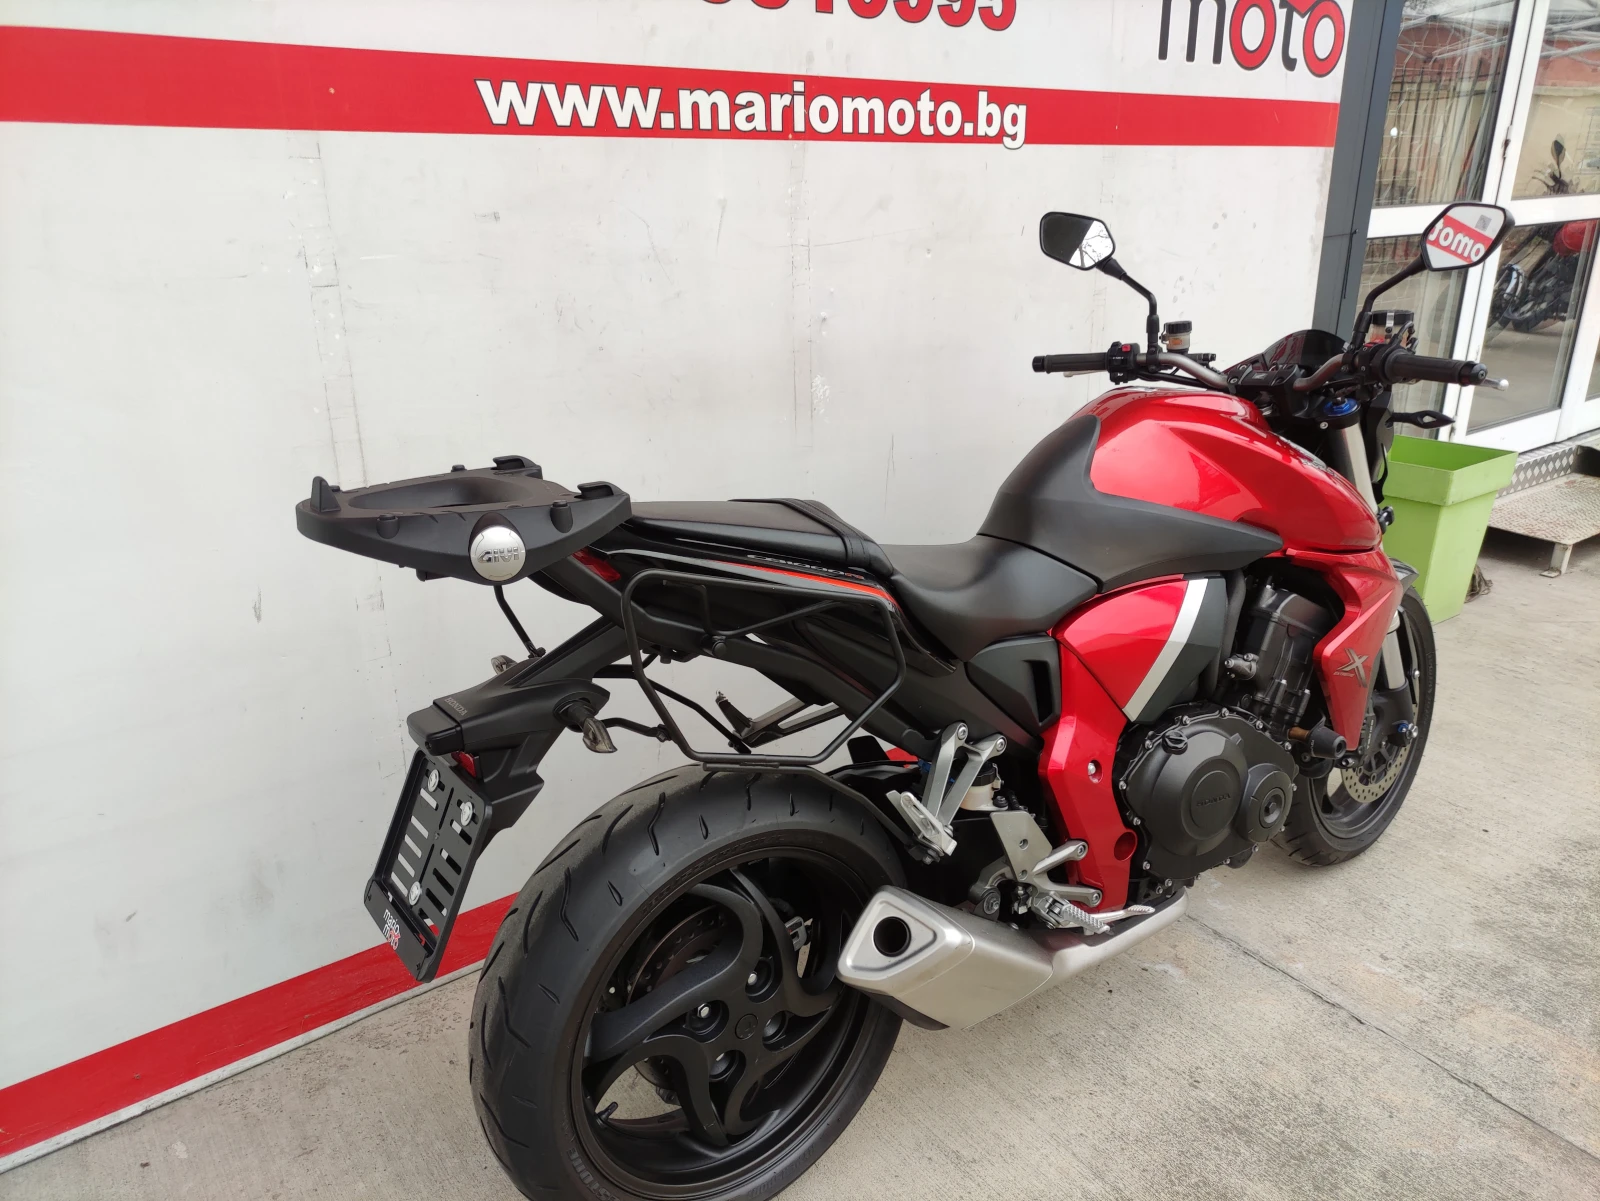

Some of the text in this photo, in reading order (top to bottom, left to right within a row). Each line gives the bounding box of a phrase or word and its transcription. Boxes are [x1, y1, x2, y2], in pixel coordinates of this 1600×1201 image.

[1158, 0, 1345, 78] moto
[474, 78, 1026, 150] www.mariomoto.bg
[478, 547, 519, 563] GIVI
[444, 697, 468, 716] HONDA
[1196, 793, 1231, 807] HONDA
